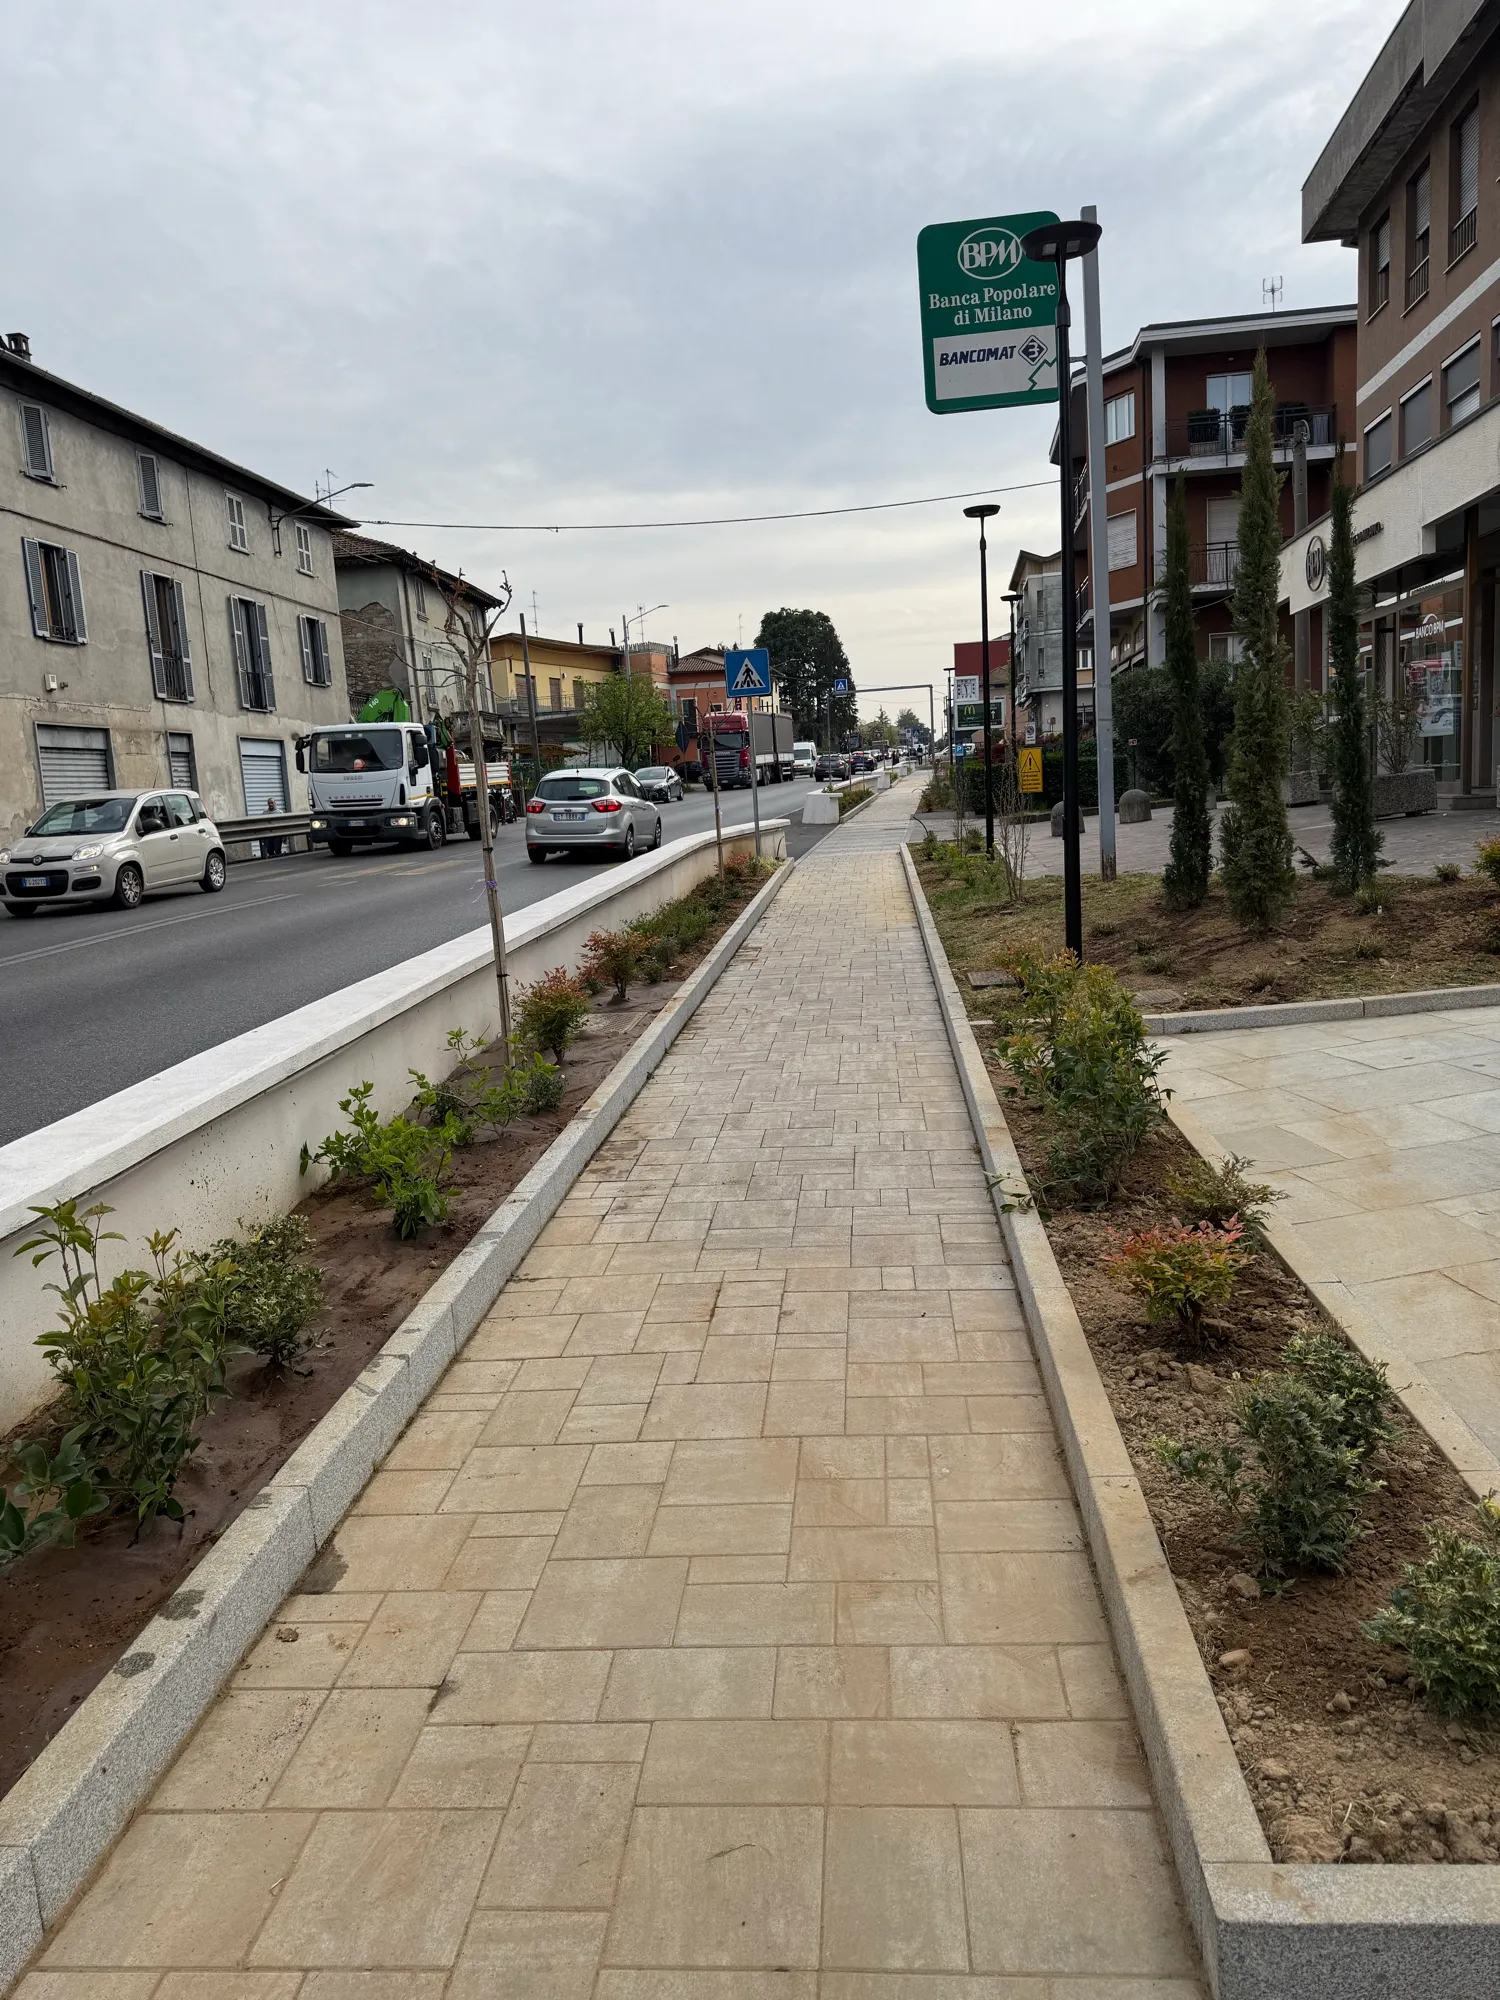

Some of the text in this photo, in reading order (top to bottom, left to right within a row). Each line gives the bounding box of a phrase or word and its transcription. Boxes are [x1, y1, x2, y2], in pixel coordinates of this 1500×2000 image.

[963, 239, 1017, 269] BPM
[928, 283, 1056, 309] Banca Popolare
[954, 306, 1032, 325] di Milano
[939, 345, 1016, 366] BANCOMAT
[1415, 619, 1444, 639] BANCO BPM
[369, 698, 379, 708] 140
